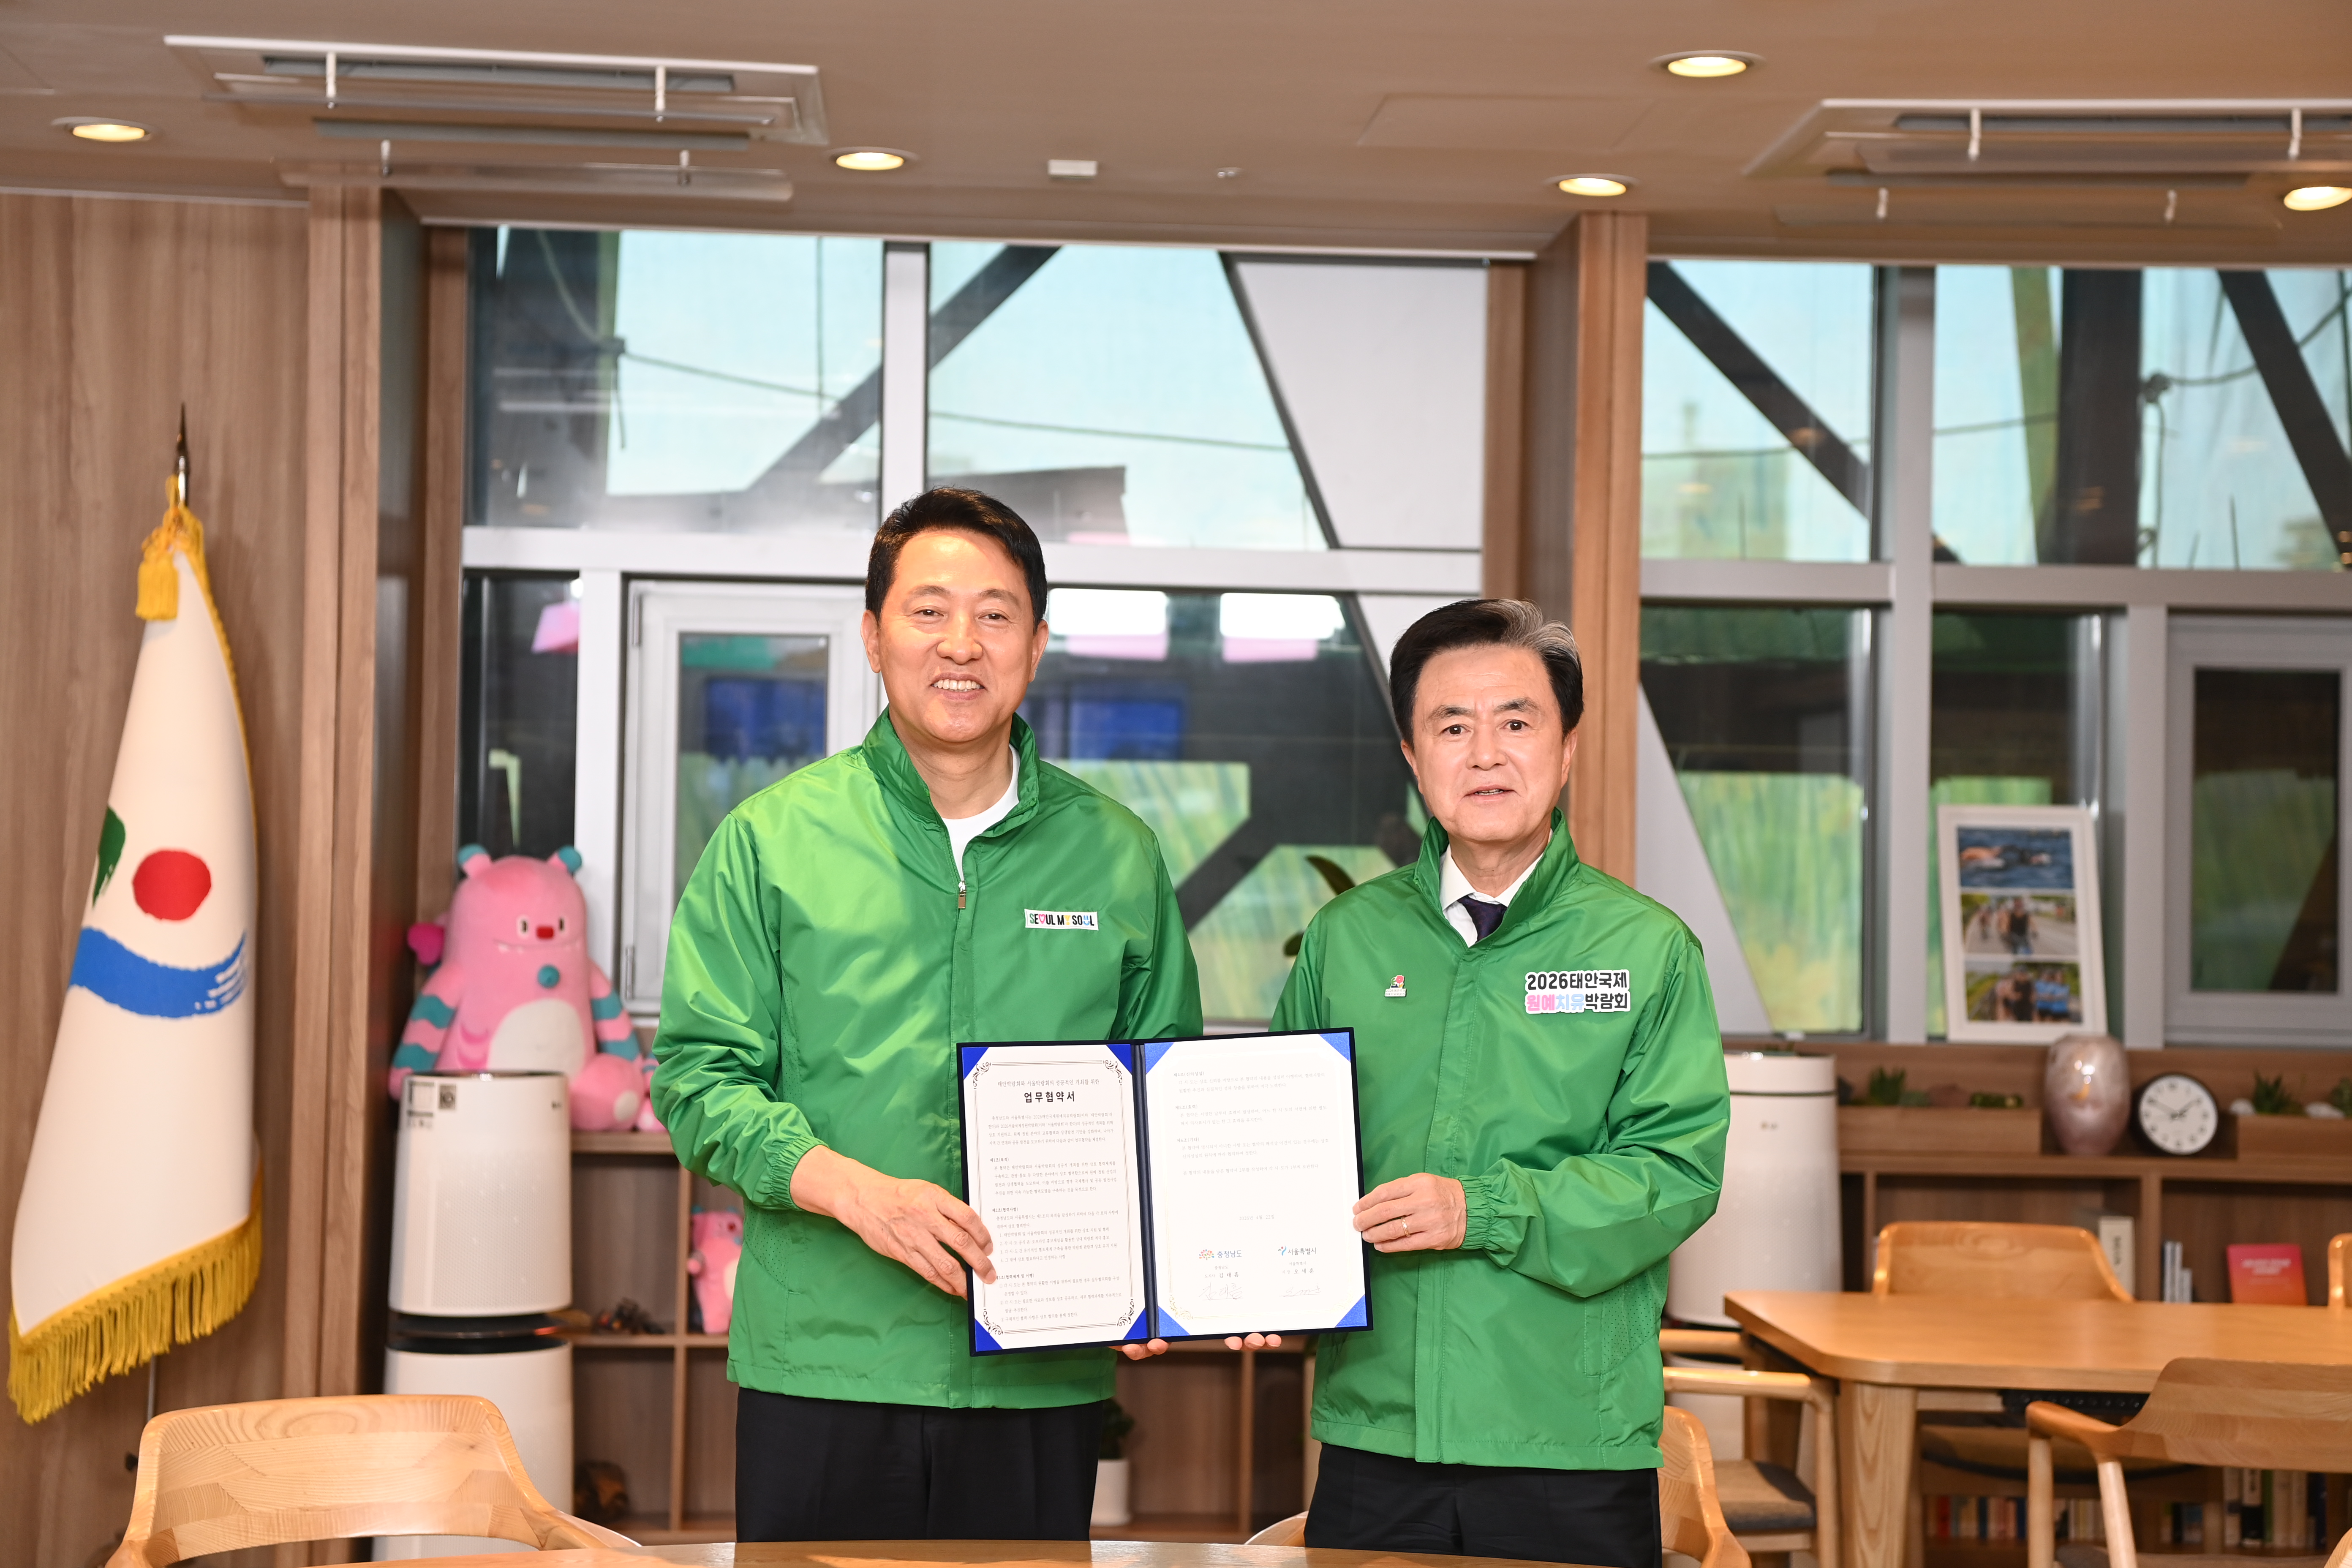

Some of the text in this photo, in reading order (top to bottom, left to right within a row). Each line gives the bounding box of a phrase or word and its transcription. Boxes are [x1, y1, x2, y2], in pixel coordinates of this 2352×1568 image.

[1527, 972, 1627, 990] 2026태안국제
[1527, 993, 1627, 1011] 원예치유박람회
[1024, 1091, 1075, 1103] 업무협약서
[1217, 1250, 1242, 1258] 충청남도
[1288, 1247, 1317, 1255] 서울특별시
